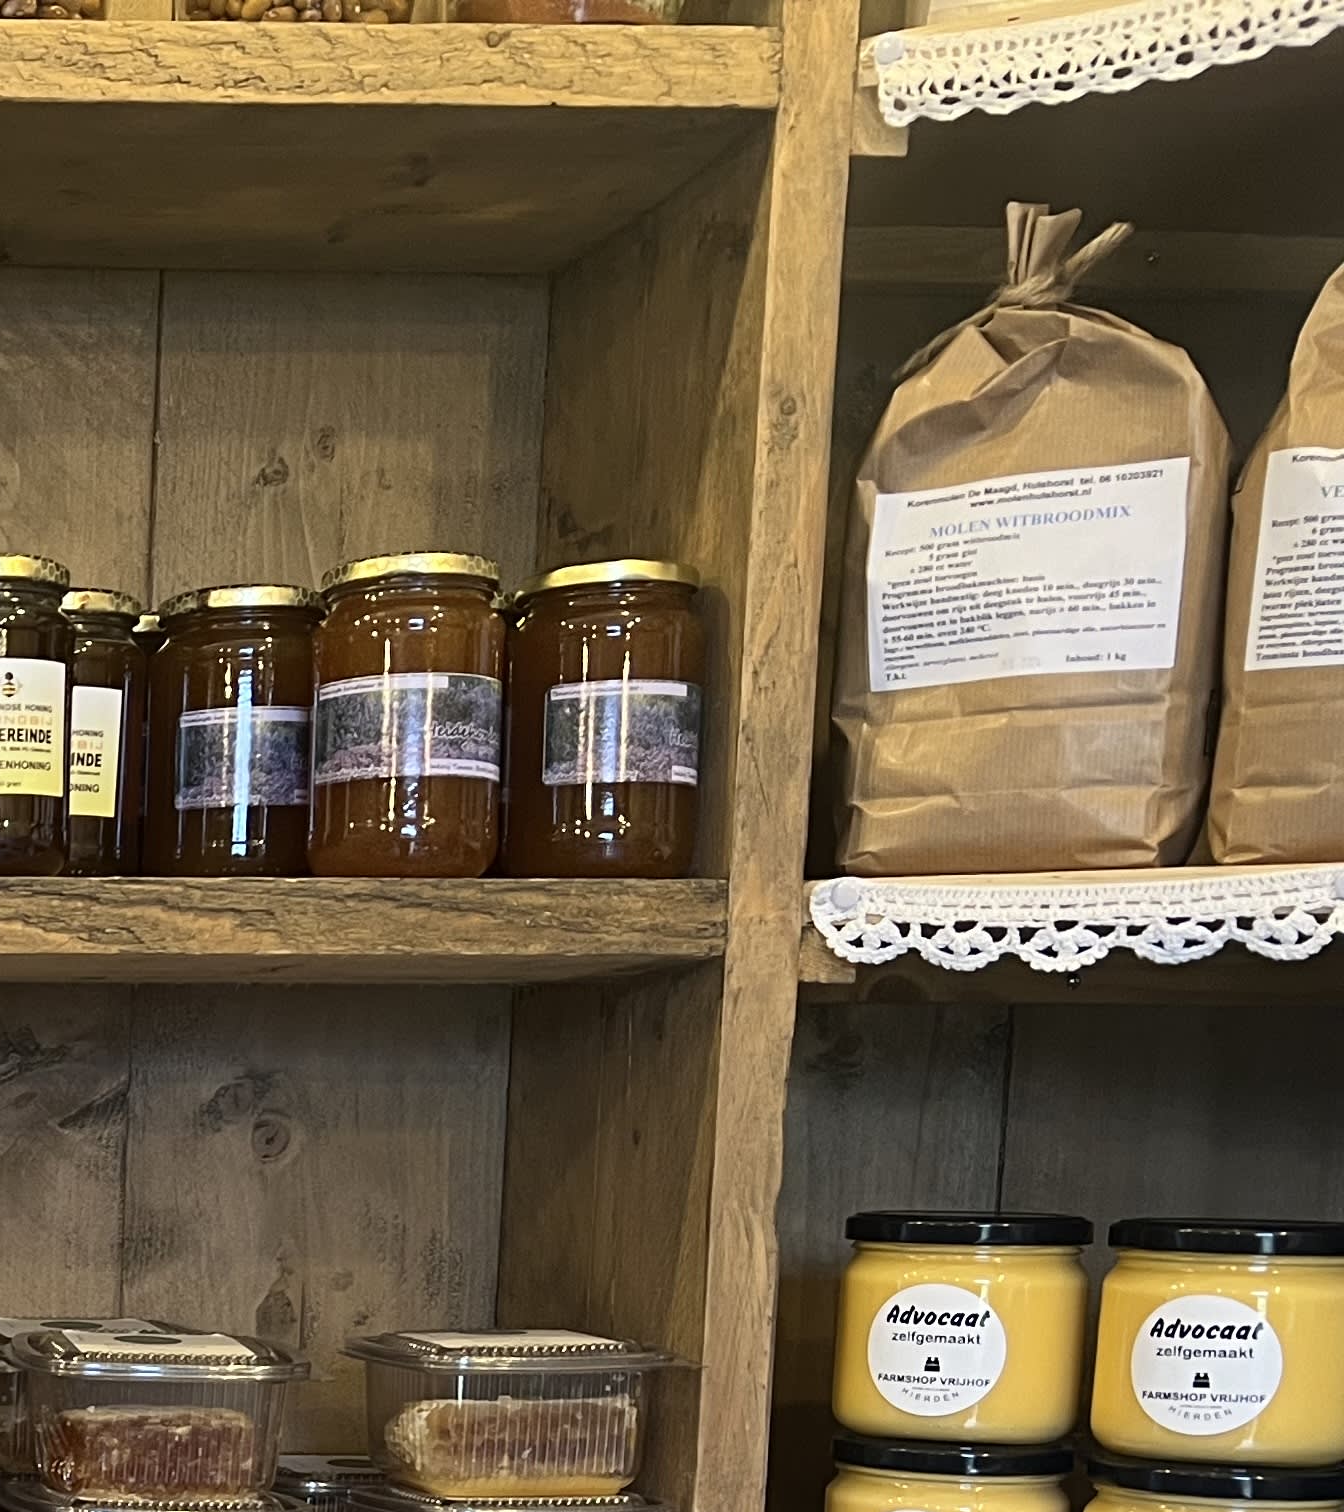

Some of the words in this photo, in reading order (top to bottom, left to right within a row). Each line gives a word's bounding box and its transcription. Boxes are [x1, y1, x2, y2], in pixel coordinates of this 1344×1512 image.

[929, 518, 991, 539] MOLEN
[996, 504, 1132, 528] WITBROODMIX
[25, 704, 52, 713] HONING
[887, 1304, 990, 1327] Advocaat
[1150, 1318, 1264, 1340] Advocaat
[892, 1332, 981, 1345] zelfgemaakt
[1156, 1346, 1254, 1360] zelfgemaakt
[878, 1373, 937, 1385] FARMSHOP
[940, 1377, 990, 1387] VRIJHOF
[1142, 1391, 1207, 1402] FARMSHOP
[1210, 1394, 1266, 1403] VRIJHOF
